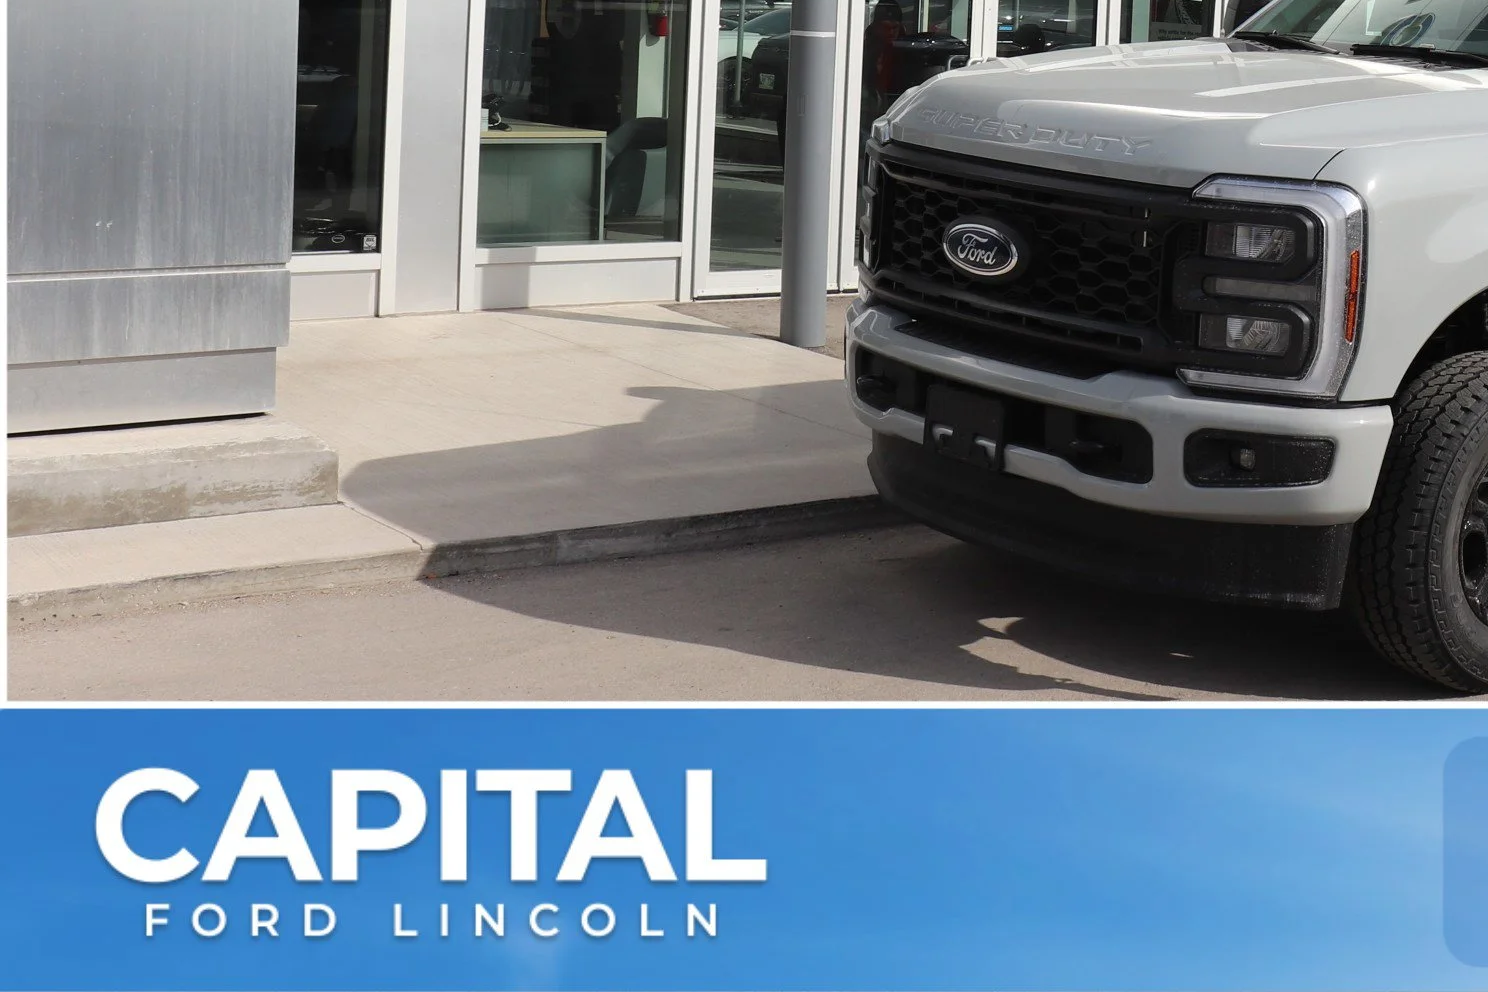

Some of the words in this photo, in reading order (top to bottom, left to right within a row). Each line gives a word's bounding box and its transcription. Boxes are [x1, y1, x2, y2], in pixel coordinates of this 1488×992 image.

[918, 108, 1024, 140] SUPER
[1029, 126, 1154, 156] DUTY
[957, 233, 998, 265] Ford
